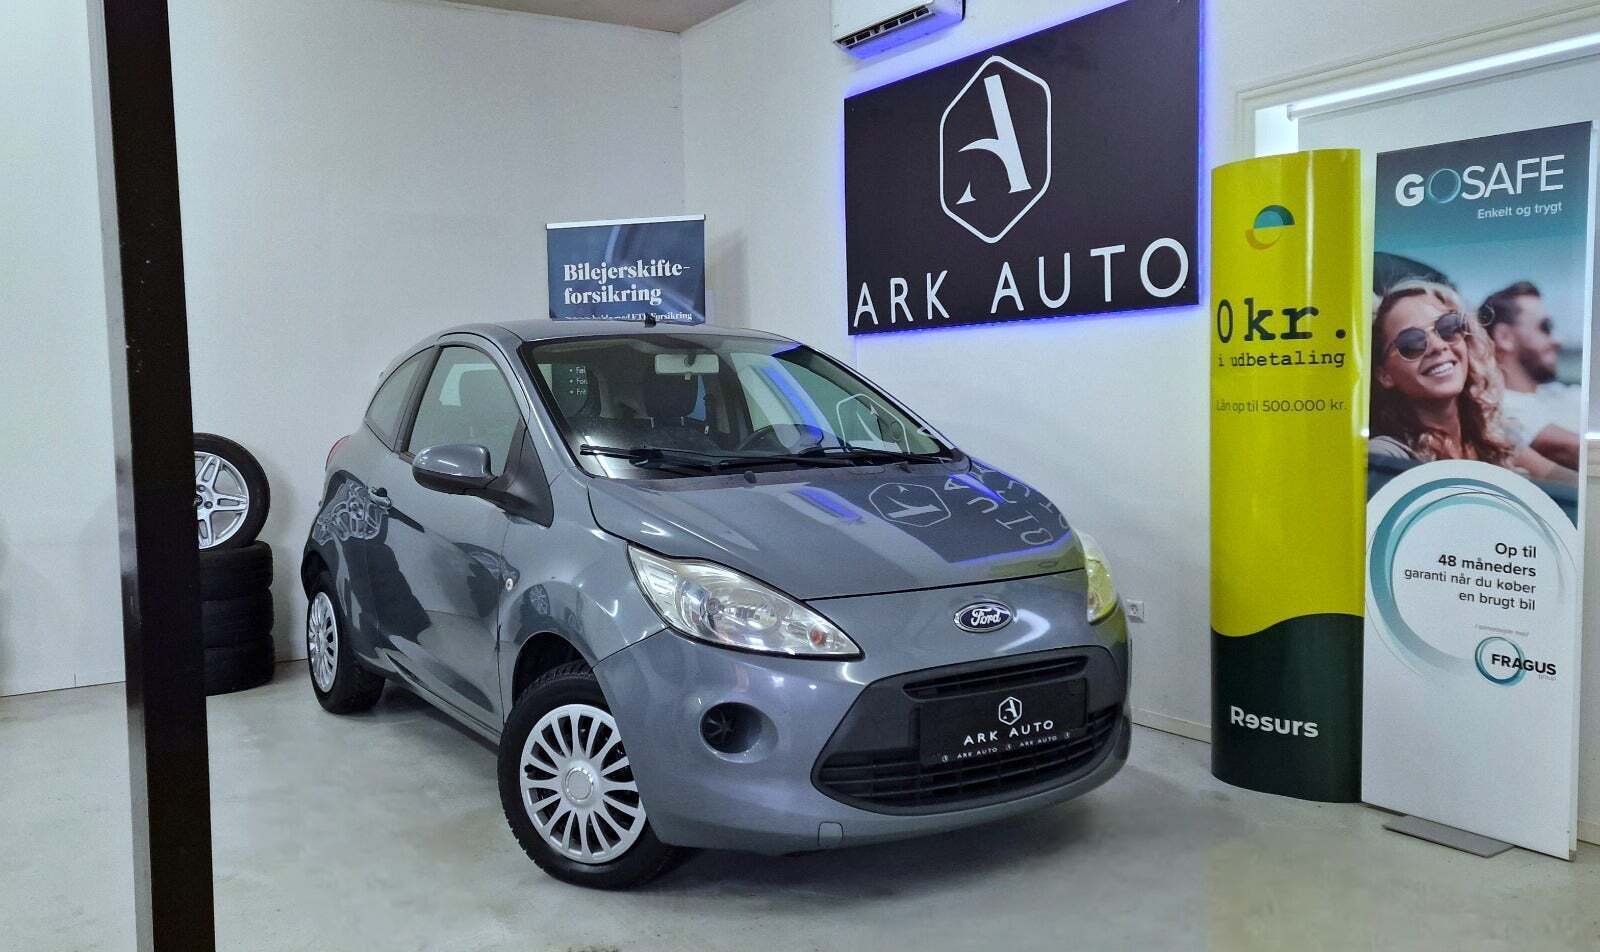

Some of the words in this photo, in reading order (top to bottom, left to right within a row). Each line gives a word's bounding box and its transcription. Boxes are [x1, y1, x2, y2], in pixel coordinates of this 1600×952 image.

[1395, 154, 1565, 207] GOSAFE
[1477, 207, 1513, 219] Enkelt
[1515, 206, 1531, 216] og
[1534, 201, 1563, 215] trygt
[563, 258, 692, 285] Bilejerskifte-
[853, 269, 951, 328] ARK
[990, 237, 1190, 314] AUTO
[564, 284, 662, 306] forsikring
[1217, 299, 1234, 344] 0
[1244, 297, 1347, 342] kr.
[1218, 353, 1225, 367] i
[1231, 350, 1346, 368] udbetaling
[1232, 401, 1245, 414] op
[1247, 400, 1259, 411] til
[1262, 400, 1326, 412] 500.000
[1331, 399, 1348, 411] kr.
[1495, 542, 1517, 559] Op
[1523, 546, 1537, 558] til
[1438, 554, 1457, 567] 48
[1461, 558, 1537, 577] måneders
[1404, 569, 1447, 582] garanti
[1450, 572, 1472, 585] når
[1475, 577, 1492, 588] du
[1496, 578, 1537, 594] køber
[1459, 592, 1475, 601] en
[1479, 593, 1515, 610] brugt
[1519, 599, 1536, 611] bil
[970, 608, 1002, 626] Ford
[1491, 653, 1557, 676] FRAGUS
[963, 730, 999, 747] ARK
[1008, 719, 1054, 739] AUTO
[1230, 705, 1319, 738] Resurs
[956, 751, 972, 760] ARK
[976, 747, 998, 756] AUTO
[1019, 740, 1034, 748] ARK
[1037, 734, 1058, 744] AUTO
